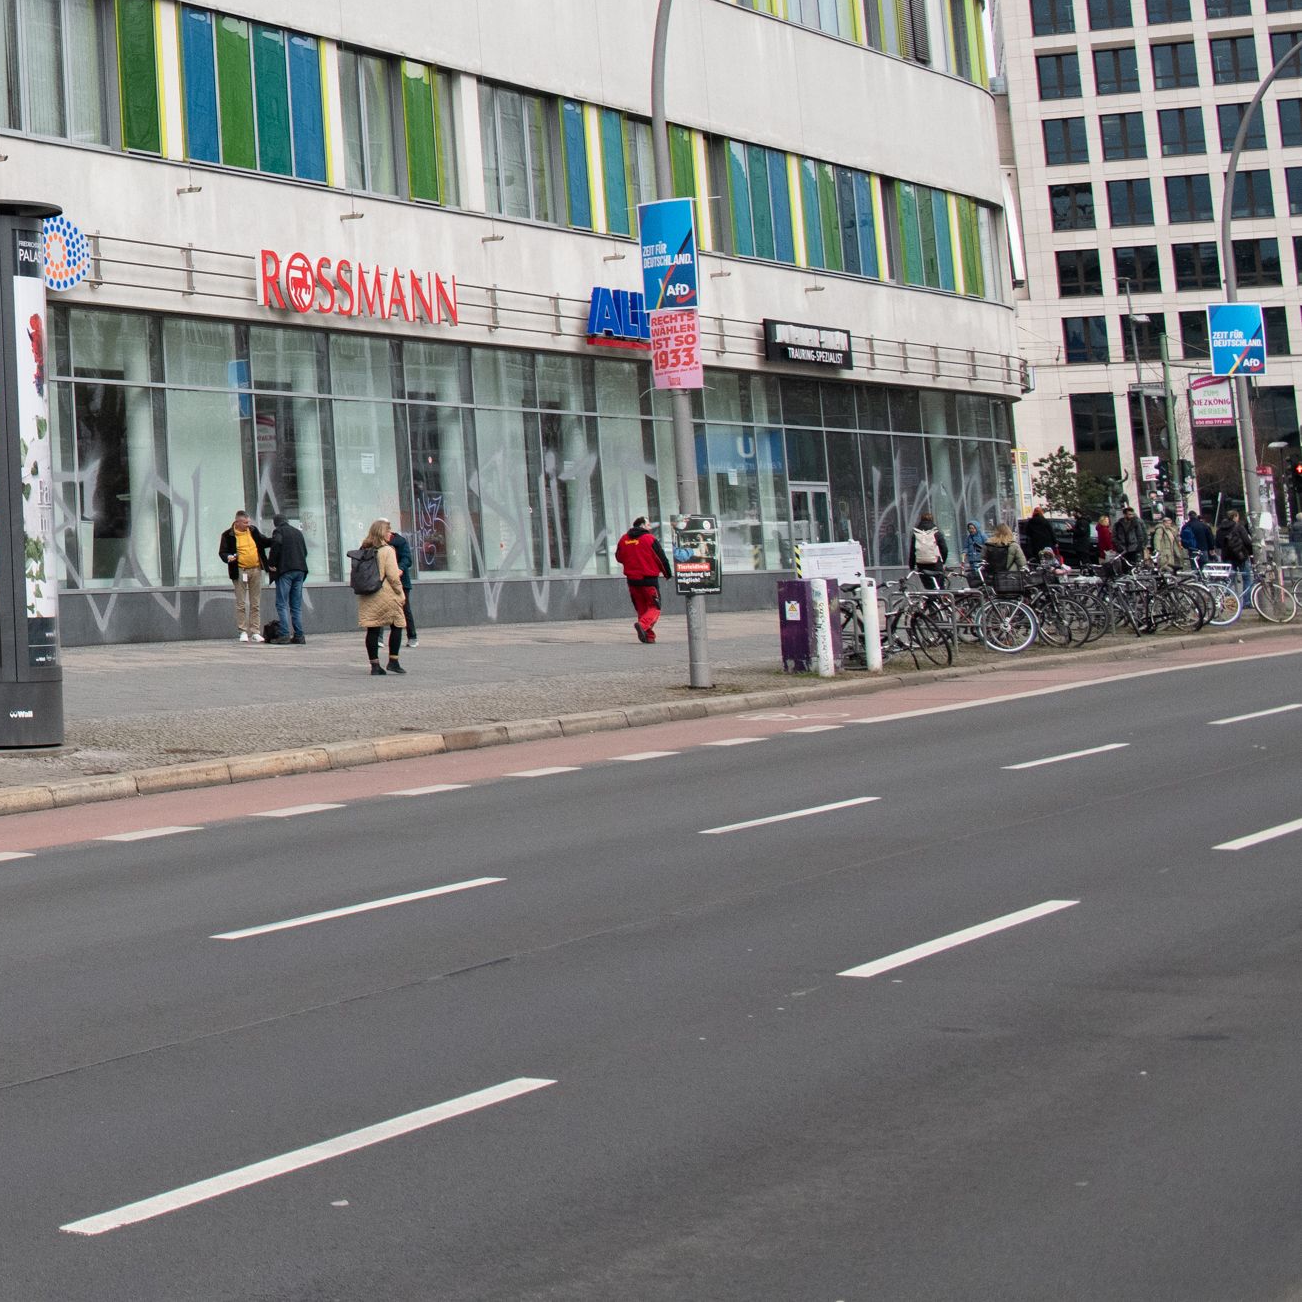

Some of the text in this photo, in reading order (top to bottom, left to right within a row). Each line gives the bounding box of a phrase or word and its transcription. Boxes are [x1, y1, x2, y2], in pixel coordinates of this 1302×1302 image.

[642, 241, 667, 257] ZEIT FÜR
[643, 253, 693, 269] DEUTSCHLAND.
[257, 249, 458, 327] ROSSMANN
[666, 283, 690, 296] AfD
[651, 312, 695, 326] RECHTS
[652, 323, 696, 337] WÄHLEN
[1212, 329, 1244, 340] ZEIT FÜR
[653, 333, 696, 350] IST SO
[1213, 338, 1263, 348] DEUTSCHLAND.
[653, 347, 699, 371] 1933.
[1242, 358, 1261, 367] AfD
